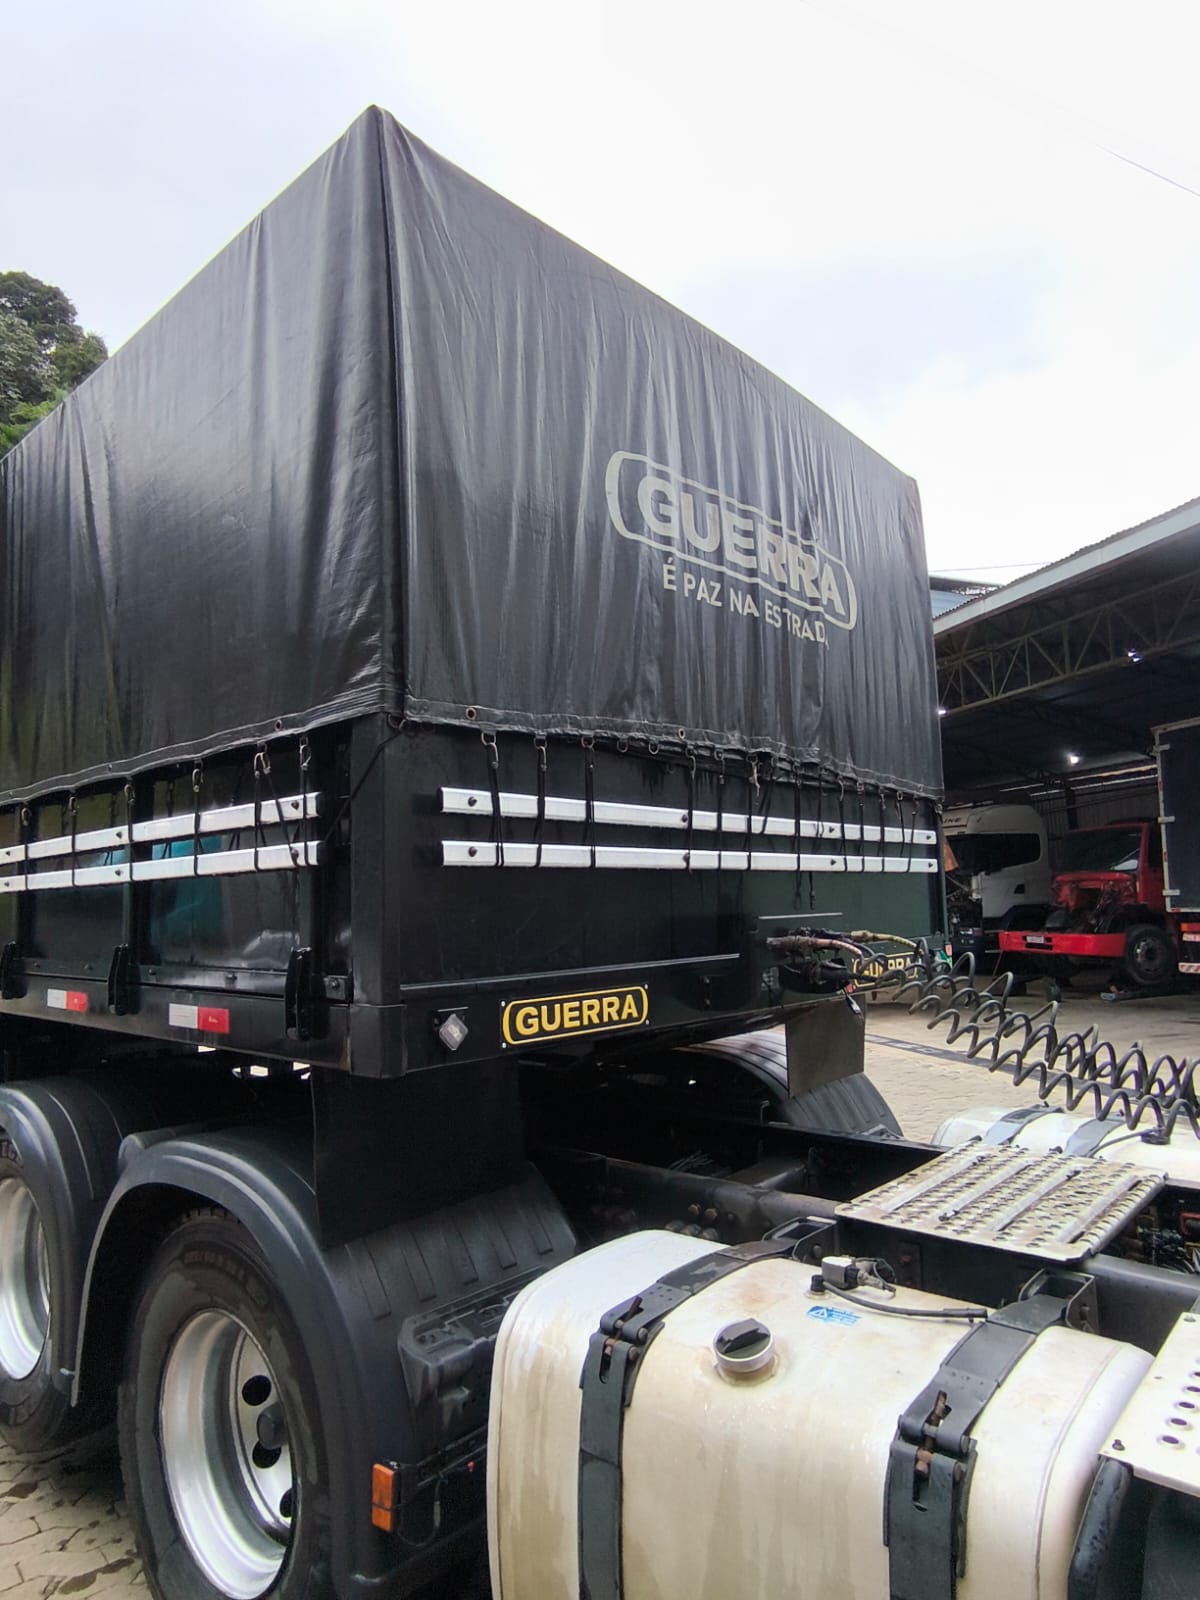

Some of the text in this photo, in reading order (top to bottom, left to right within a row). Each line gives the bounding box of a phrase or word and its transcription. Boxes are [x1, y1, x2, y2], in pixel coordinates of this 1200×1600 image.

[637, 475, 846, 616] GUERRA
[663, 557, 829, 647] É PAZ NA ESTRAD
[515, 994, 639, 1036] GUERRA
